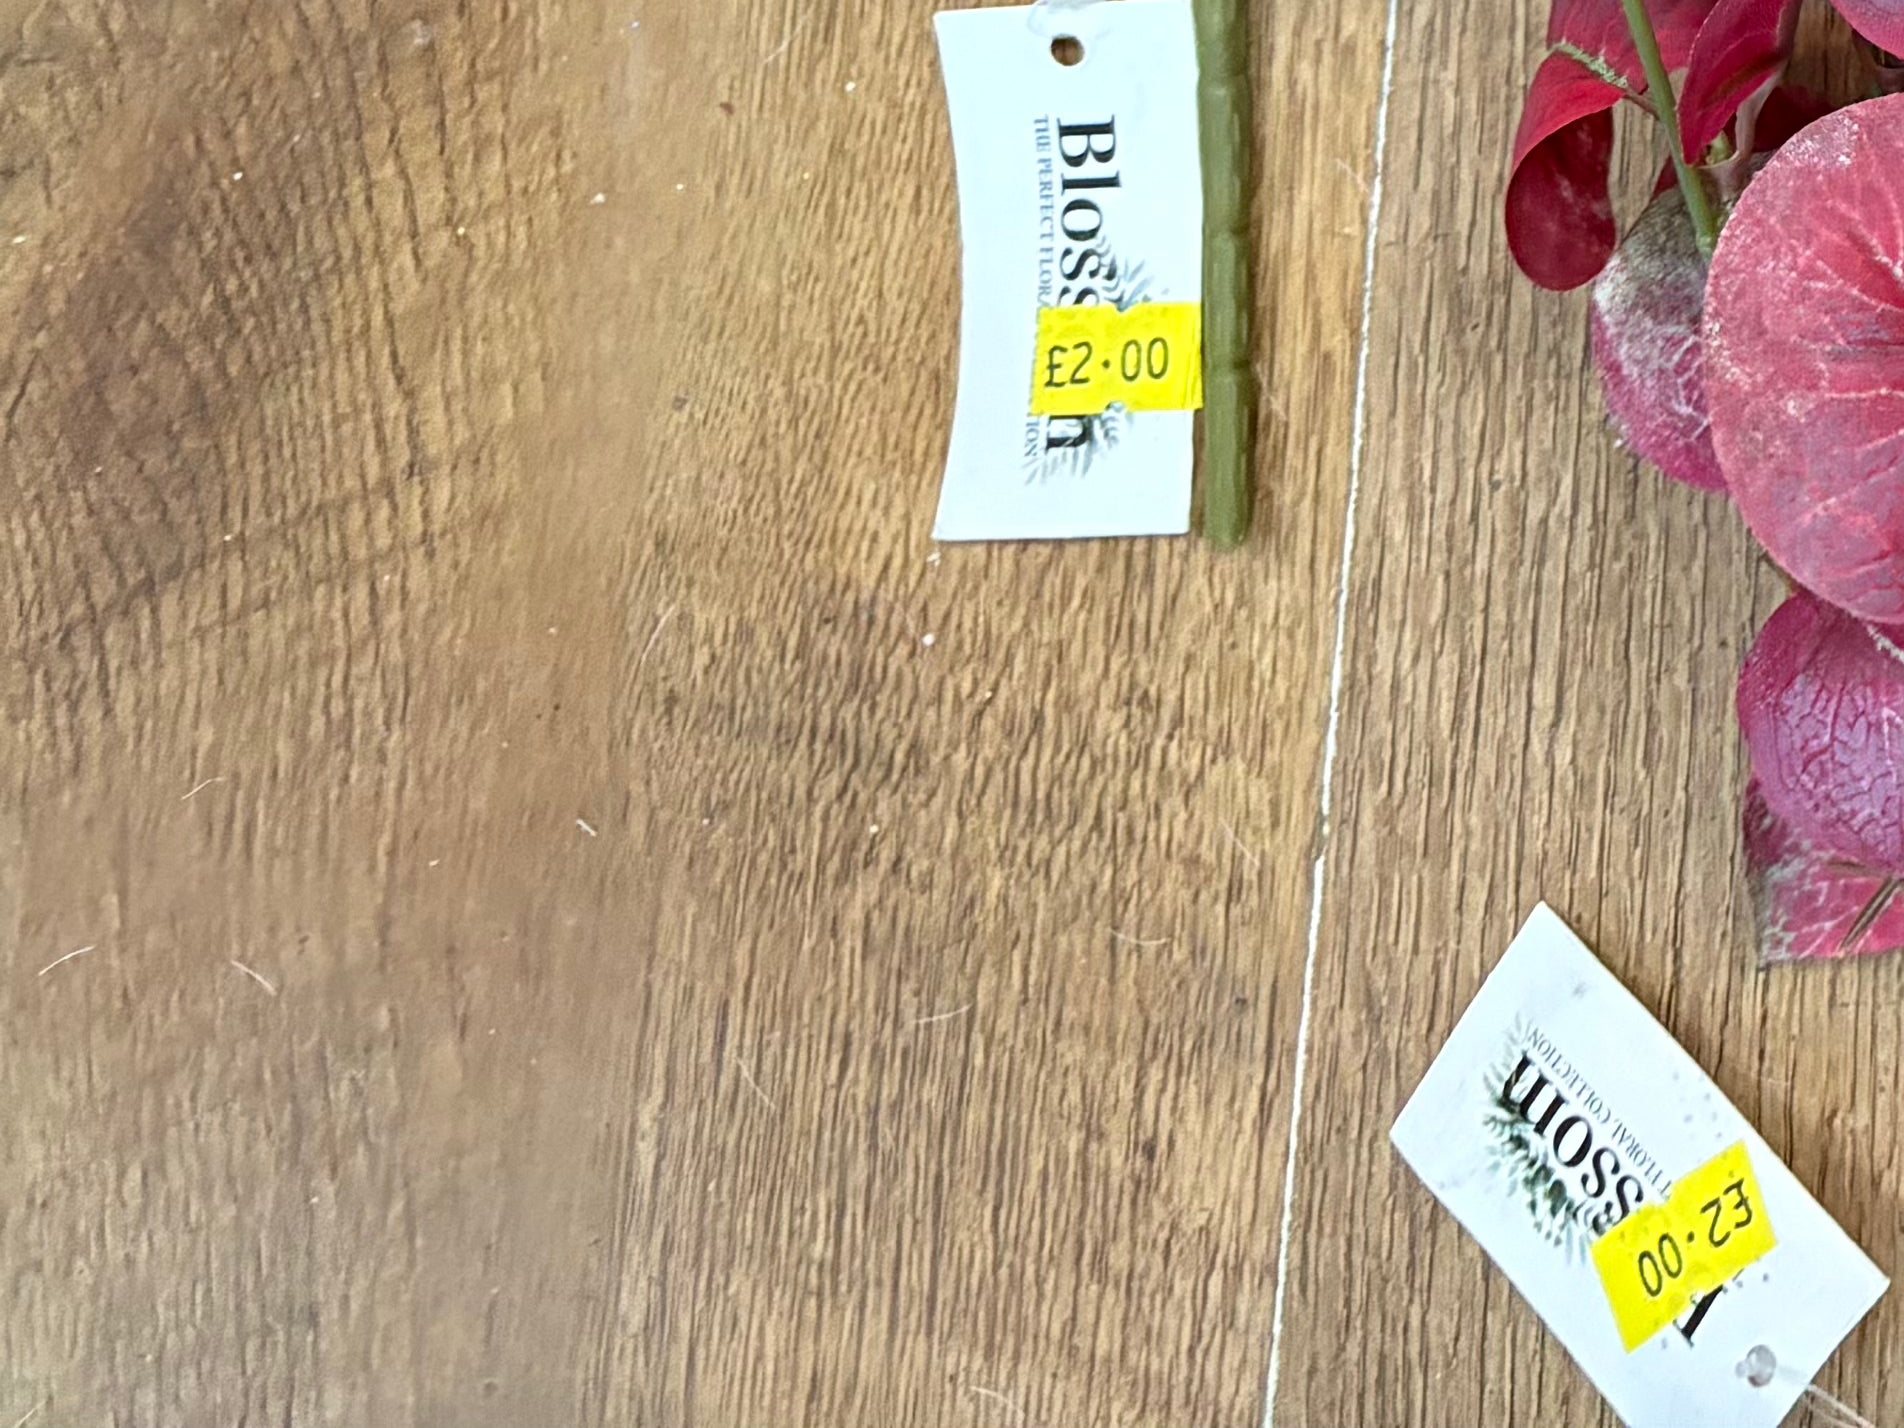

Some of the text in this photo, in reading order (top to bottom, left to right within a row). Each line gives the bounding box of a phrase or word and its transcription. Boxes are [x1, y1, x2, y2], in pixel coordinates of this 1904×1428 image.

[1034, 114, 1055, 310] THE PERFECT FLORA
[1044, 114, 1122, 455] Blossm
[1527, 1027, 1664, 1187] FLORAL COLLECTION
